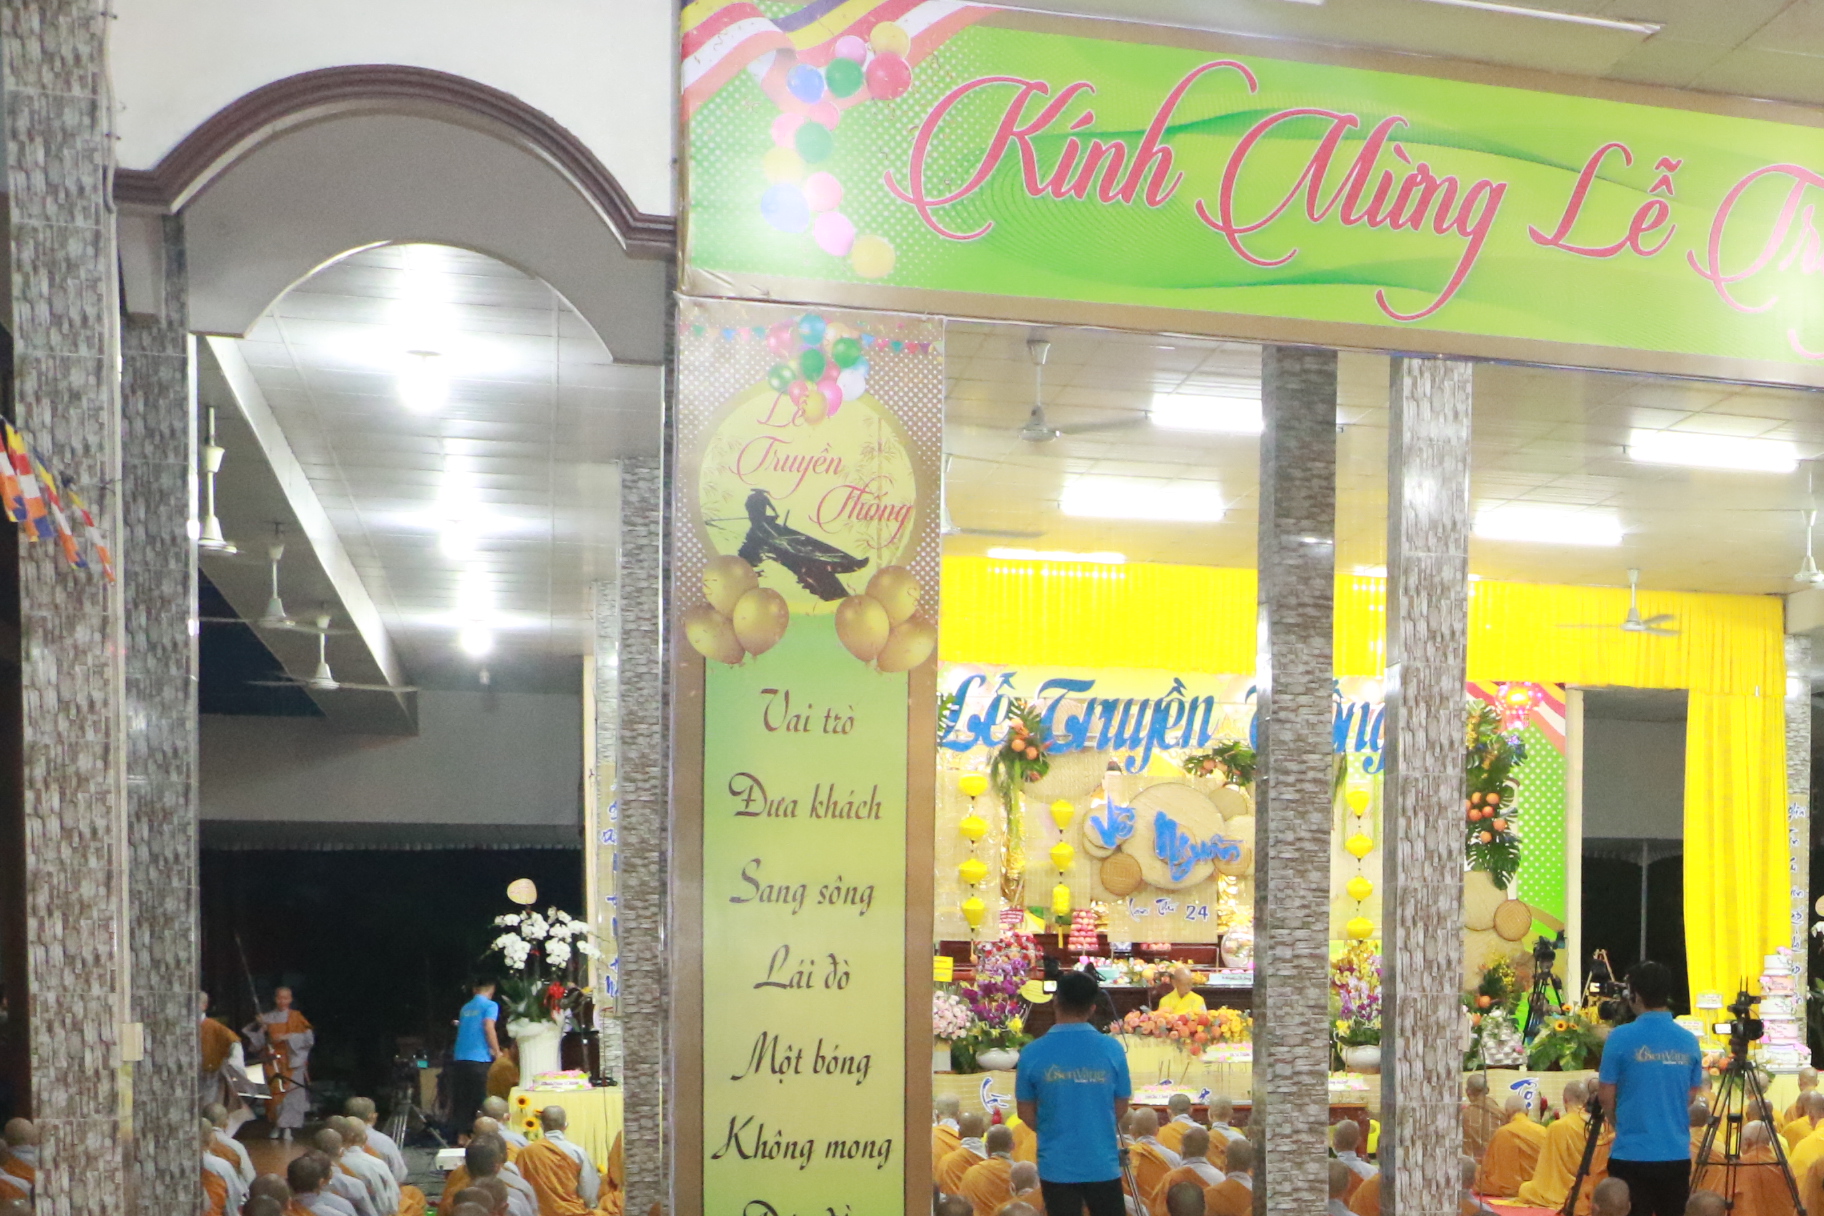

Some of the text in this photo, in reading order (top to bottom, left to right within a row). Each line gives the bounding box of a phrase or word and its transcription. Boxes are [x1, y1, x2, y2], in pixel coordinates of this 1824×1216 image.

[883, 58, 1259, 241] Kính
[1194, 106, 1508, 322] Mừng
[1525, 141, 1685, 260] Lễ
[728, 436, 842, 500] Truyền
[808, 475, 914, 550] Thống
[760, 688, 855, 735] Vai trò
[1037, 676, 1220, 774] Truyền
[728, 772, 883, 821] Đưa khách
[728, 857, 876, 917] Sang sông
[1185, 905, 1210, 922] 24
[753, 944, 851, 990] Lái đò
[730, 1031, 872, 1086] Một bóng
[711, 1114, 893, 1171] Không mong
